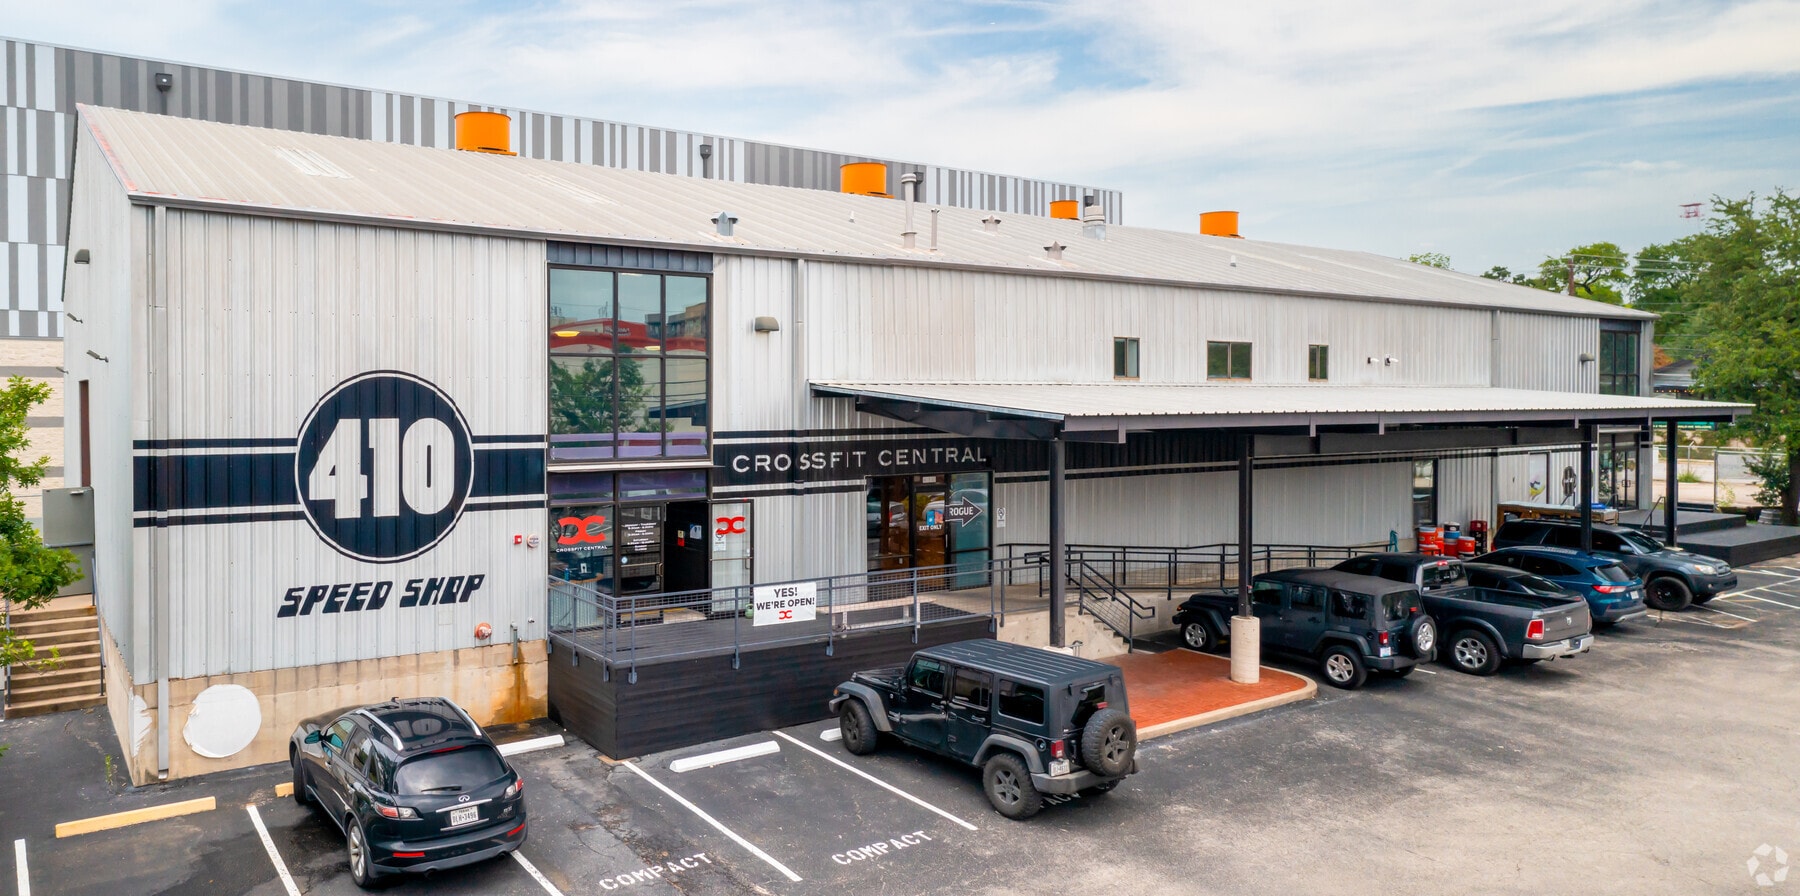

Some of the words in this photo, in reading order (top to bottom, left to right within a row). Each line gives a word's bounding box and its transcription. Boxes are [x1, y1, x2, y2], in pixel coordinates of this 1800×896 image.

[309, 417, 455, 519] 410
[732, 451, 866, 473] CROSSFIT
[878, 446, 987, 467] CENTRAL
[949, 506, 974, 516] ROGUE
[277, 581, 393, 618] SPEED
[400, 574, 485, 608] SHOP
[756, 600, 785, 611] WE'RE
[787, 597, 815, 608] OPEN!
[773, 587, 798, 598] YES!
[831, 830, 932, 866] COMPACT
[599, 852, 712, 891] COMPACT
